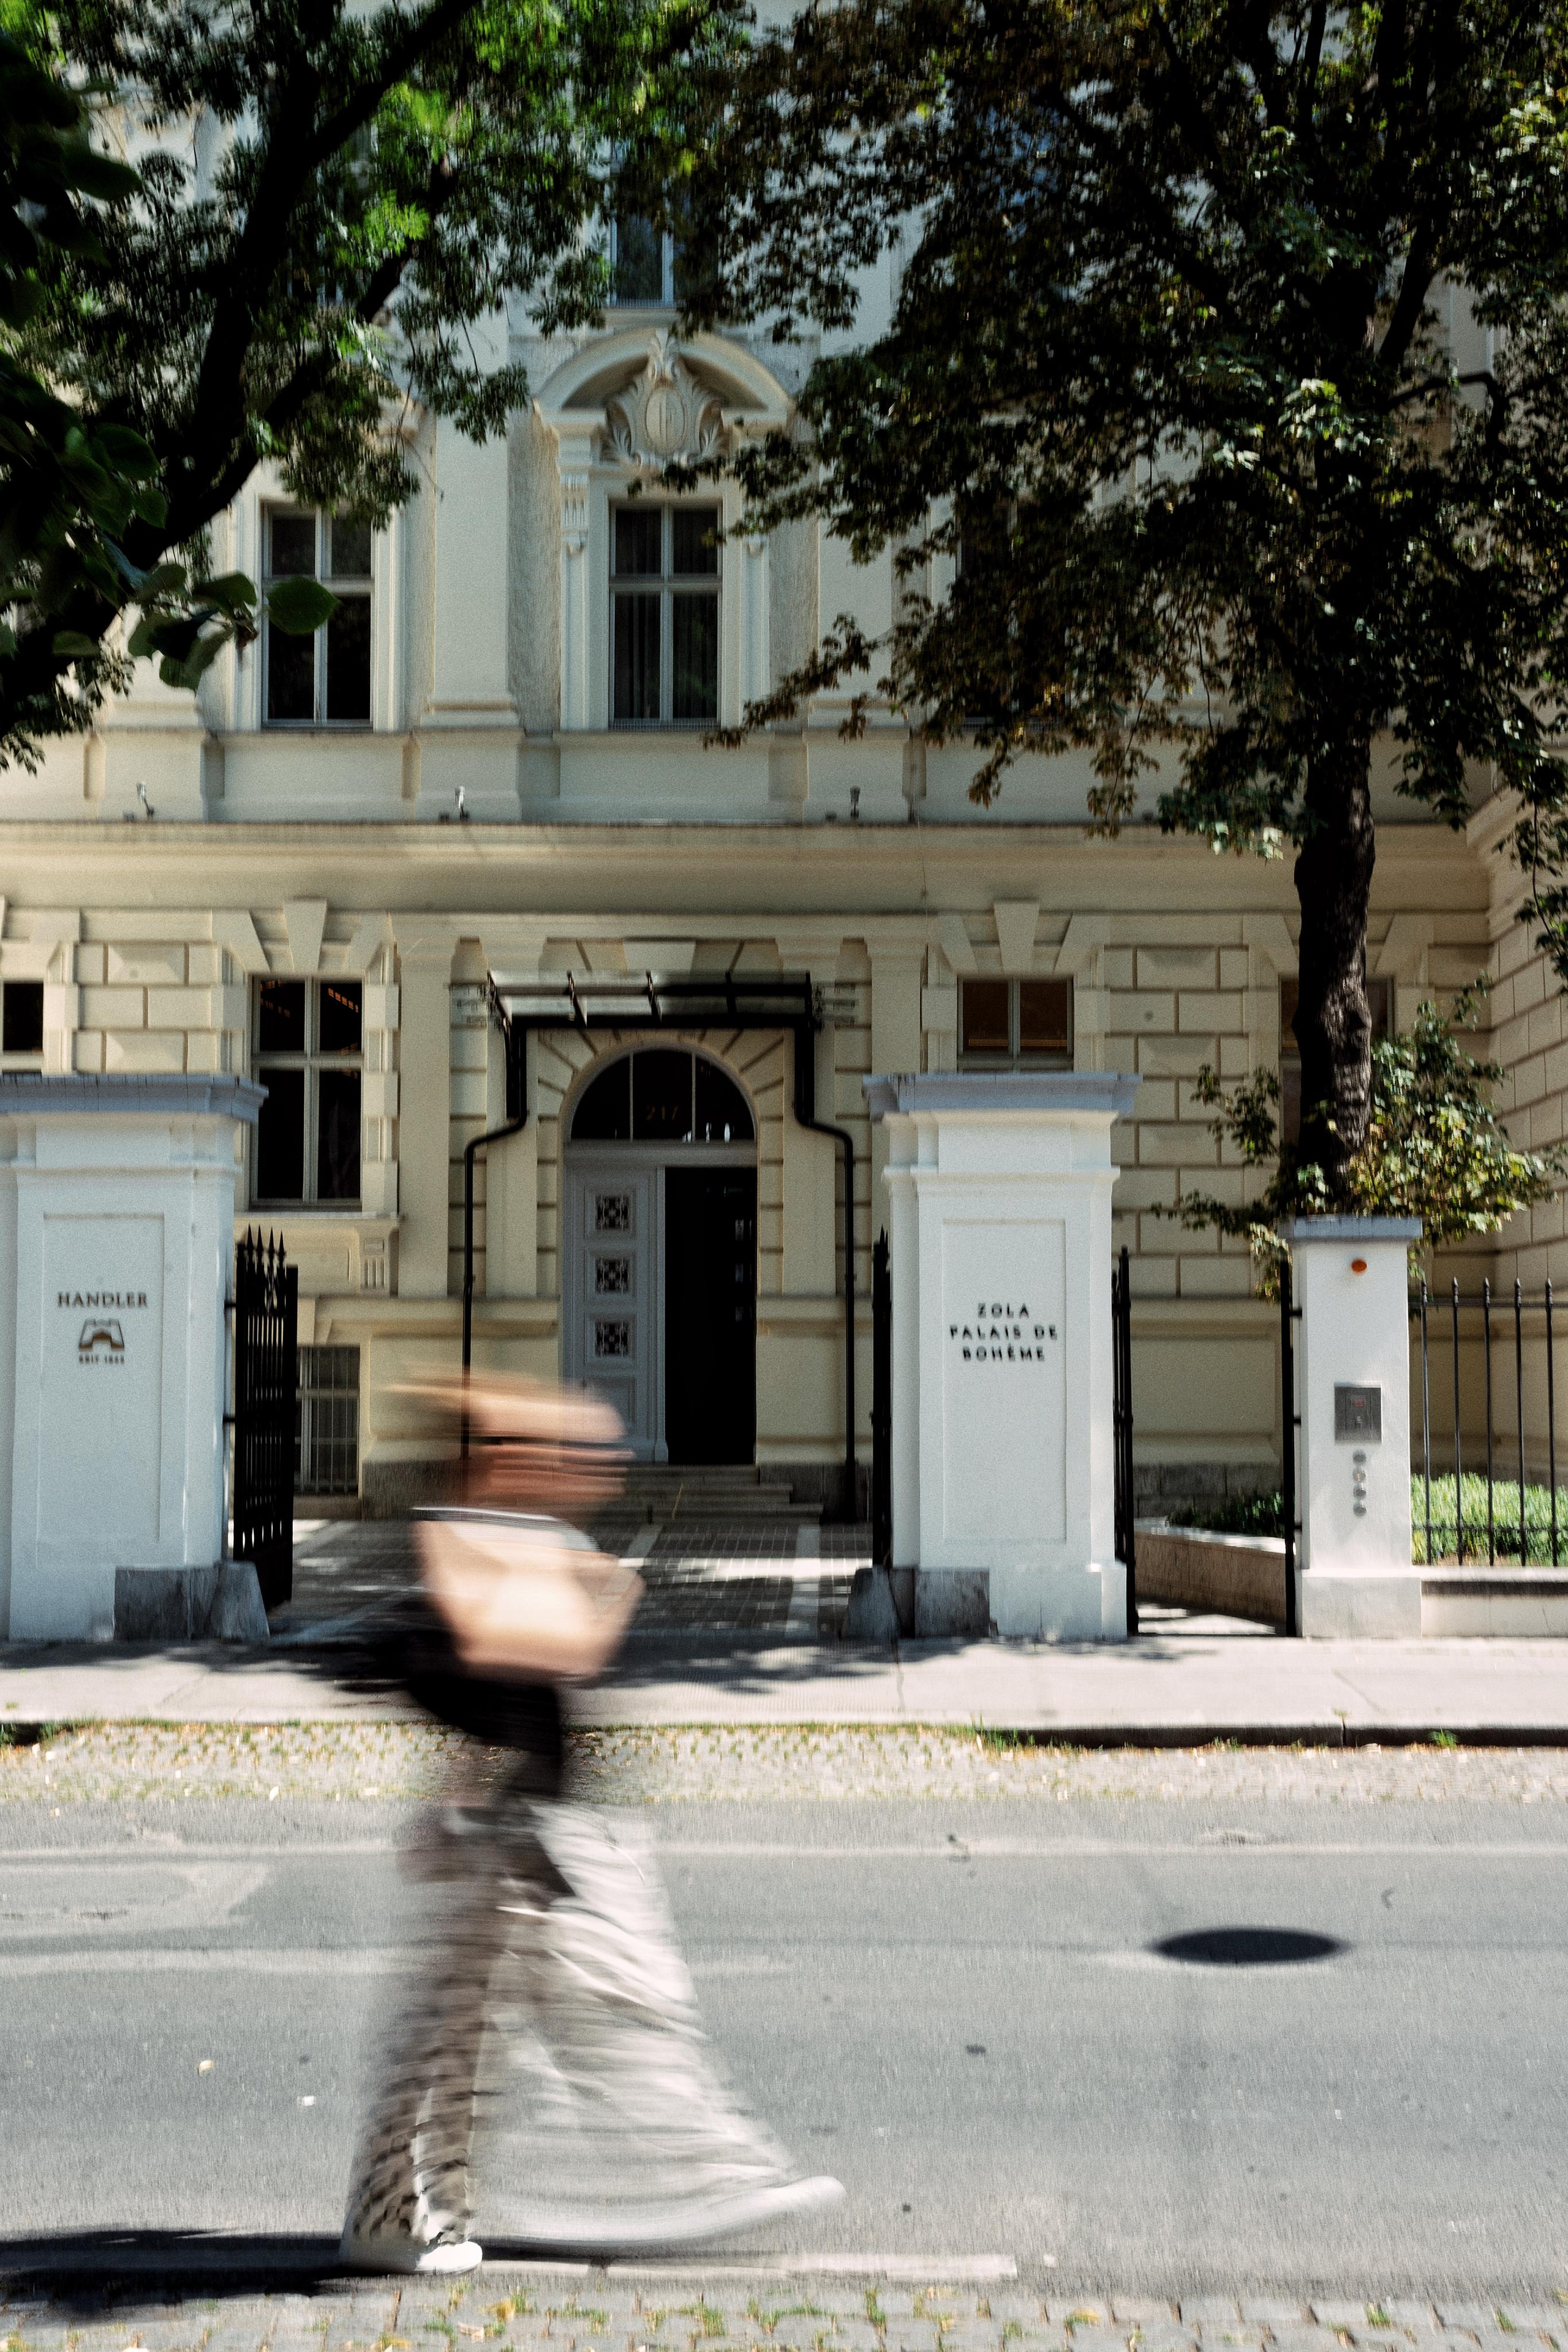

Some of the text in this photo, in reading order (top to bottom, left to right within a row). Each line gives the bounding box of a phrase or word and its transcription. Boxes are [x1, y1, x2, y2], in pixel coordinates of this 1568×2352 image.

[58, 1292, 148, 1308] HANDLER
[978, 1303, 1029, 1318] ZOLA
[950, 1324, 1057, 1340] PALAIS DE
